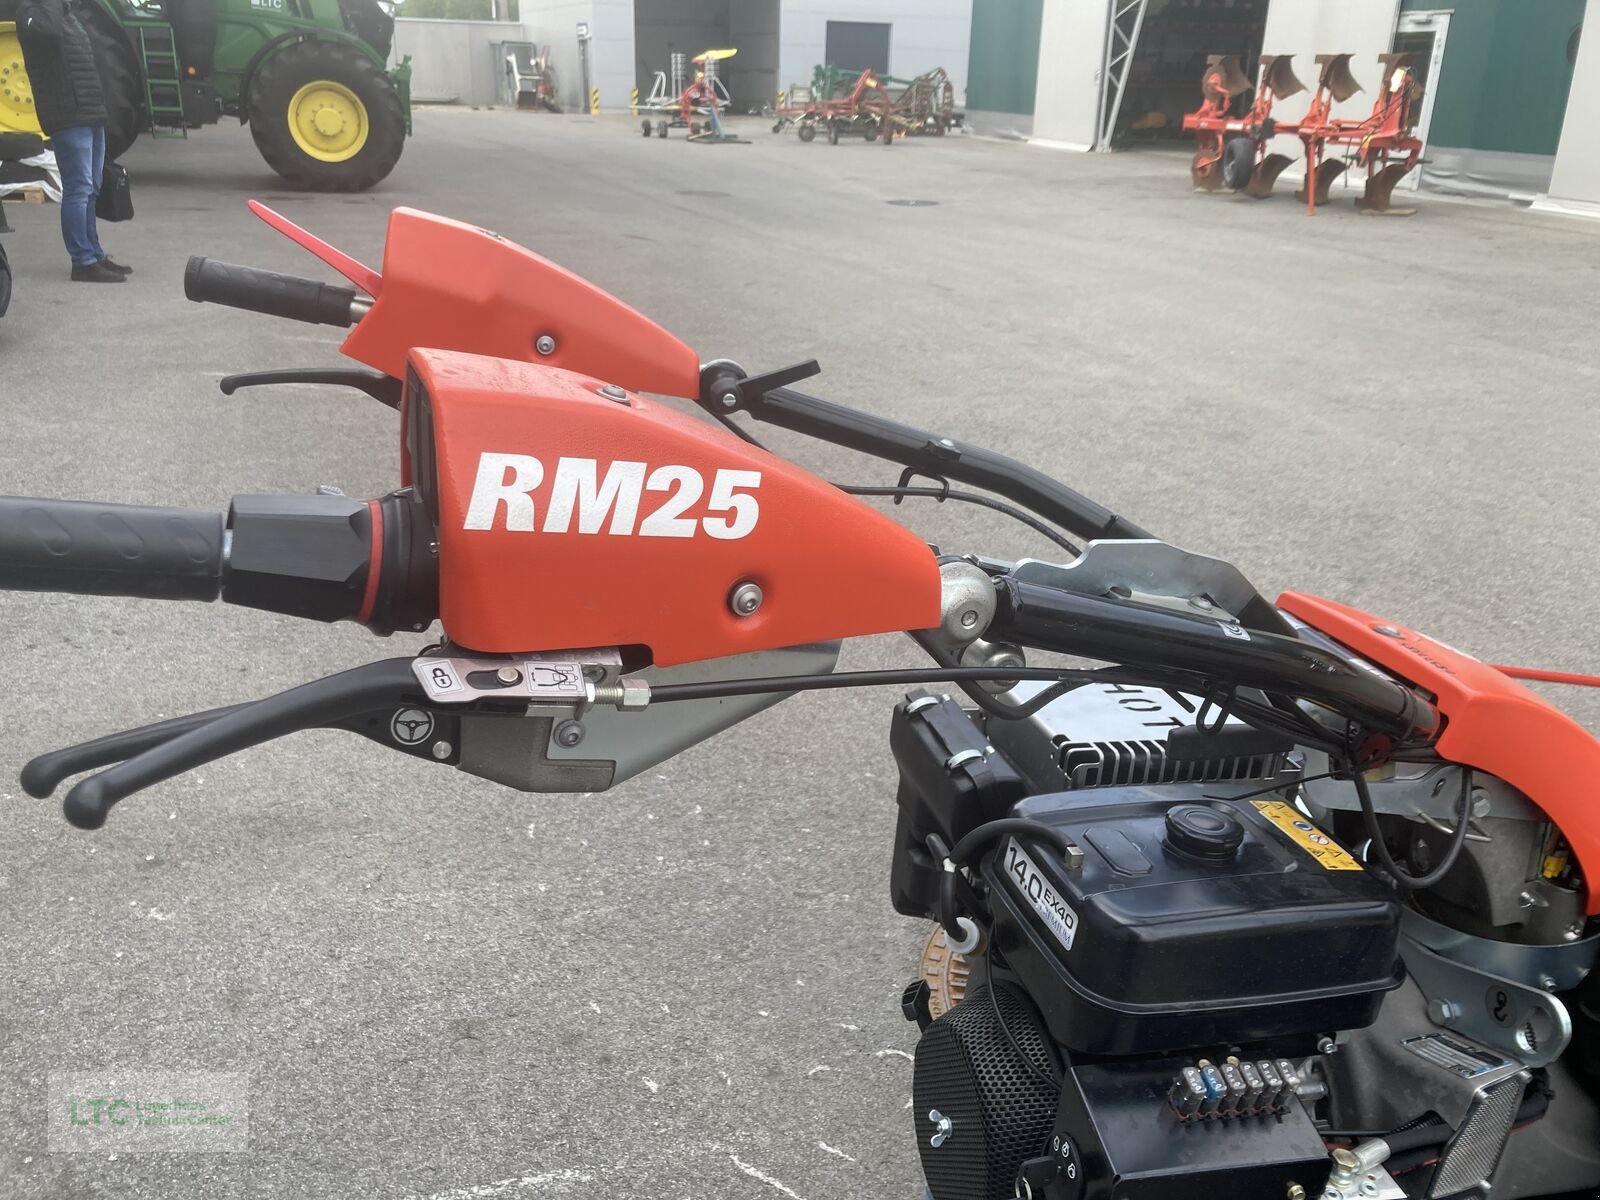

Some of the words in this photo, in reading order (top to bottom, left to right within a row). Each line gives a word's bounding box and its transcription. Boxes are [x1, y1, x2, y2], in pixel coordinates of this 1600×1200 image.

[463, 452, 762, 539] RM25
[1009, 847, 1043, 904] 14.0
[1043, 888, 1075, 930] EX40
